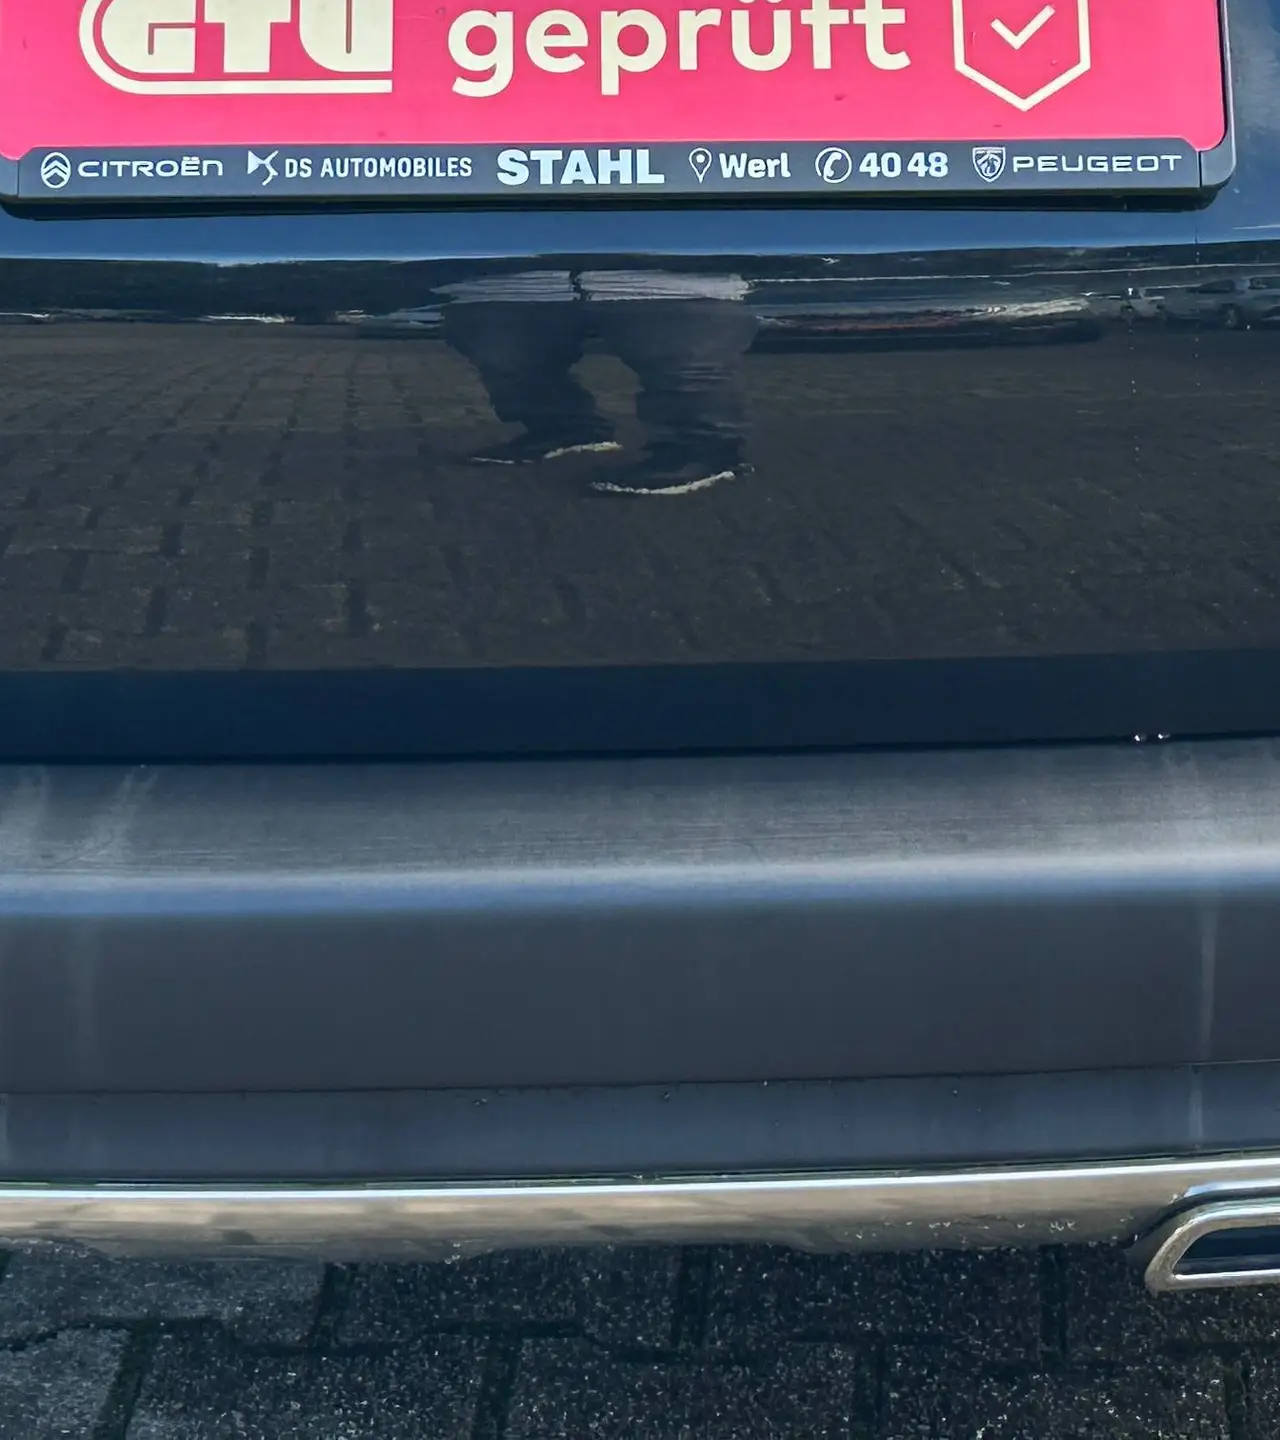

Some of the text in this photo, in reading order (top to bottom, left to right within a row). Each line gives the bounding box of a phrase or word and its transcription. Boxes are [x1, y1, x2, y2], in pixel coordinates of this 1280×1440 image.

[284, 156, 473, 179] DS AUTOMOBILES
[496, 148, 666, 186] STAHL
[718, 152, 792, 179] Werl
[1013, 155, 1182, 172] PEUGEOT
